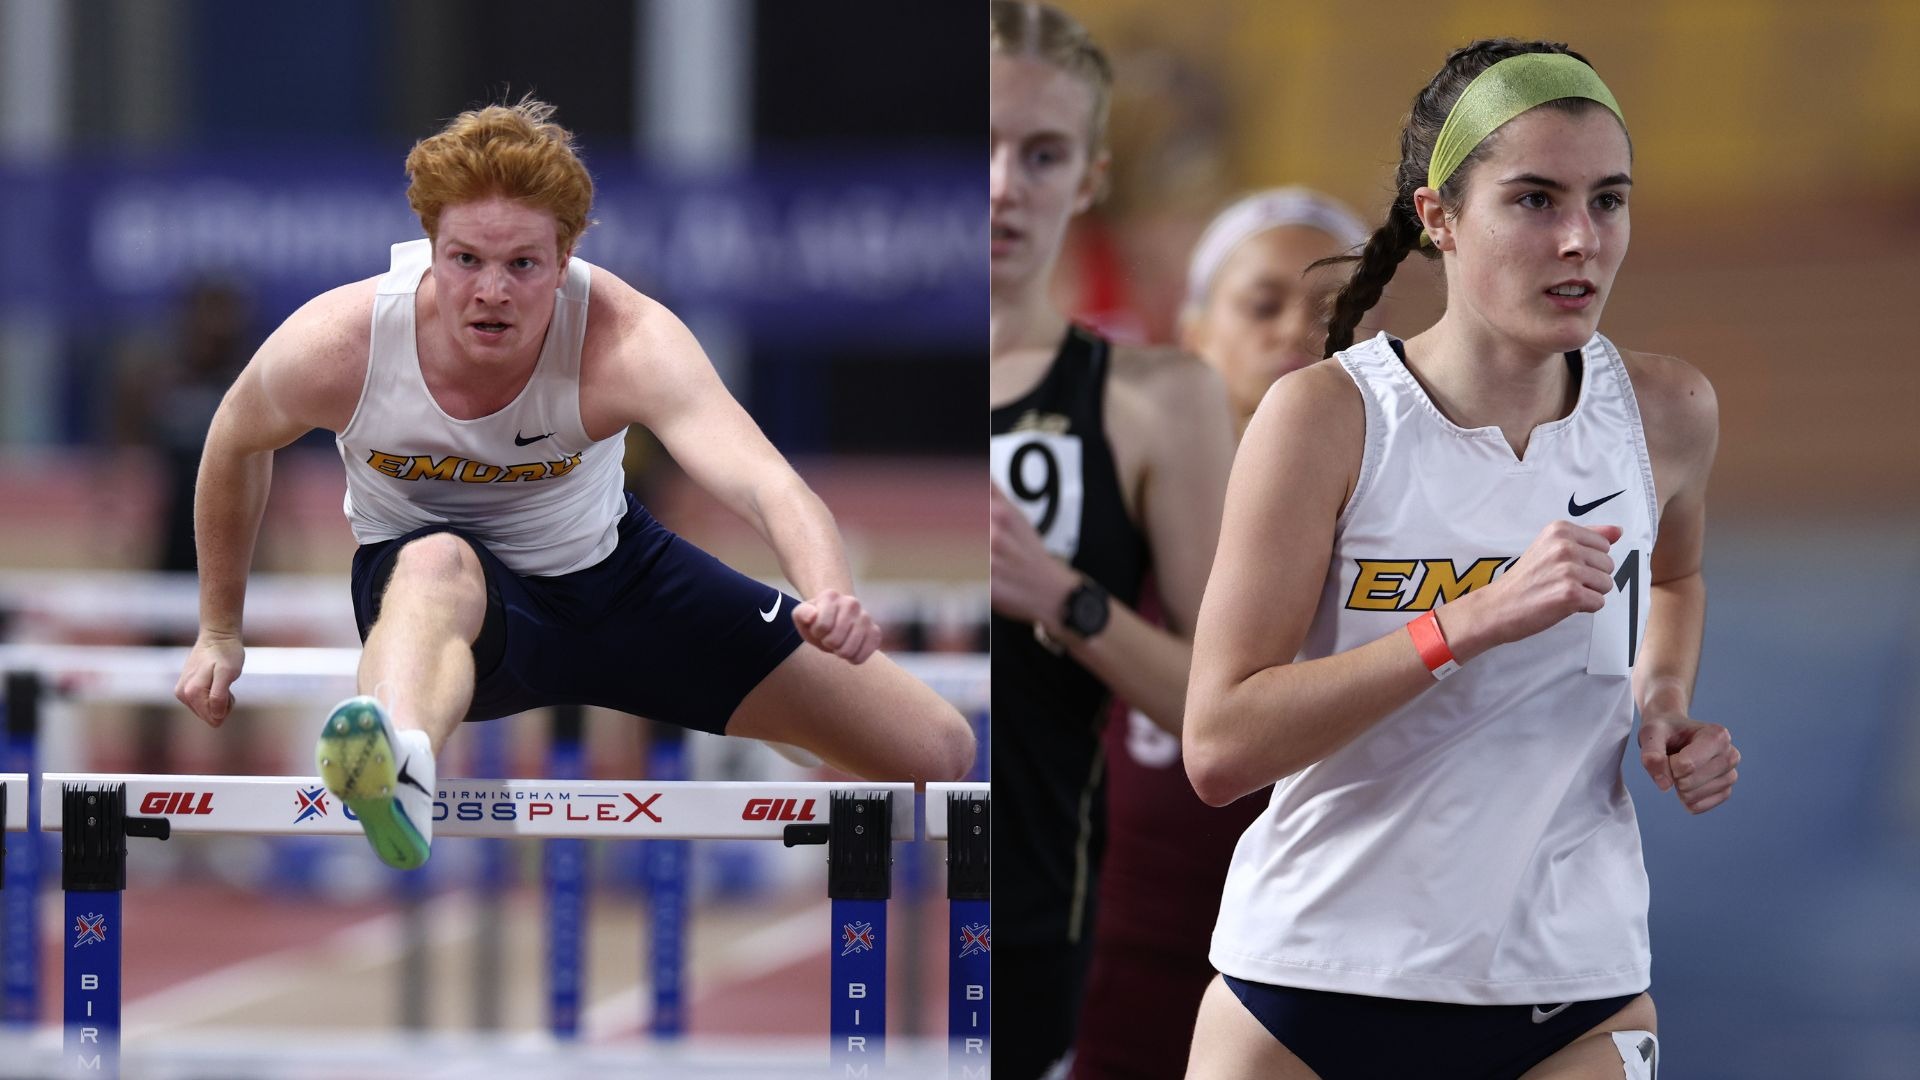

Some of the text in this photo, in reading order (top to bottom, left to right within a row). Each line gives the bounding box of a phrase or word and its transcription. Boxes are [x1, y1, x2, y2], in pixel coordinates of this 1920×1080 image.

[366, 448, 582, 484] EMORY
[1009, 441, 1060, 536] 9
[1344, 557, 1522, 612] EM
[139, 791, 214, 815] GILL
[439, 790, 571, 801] BIRMINGHAM
[741, 798, 816, 822] GILL
